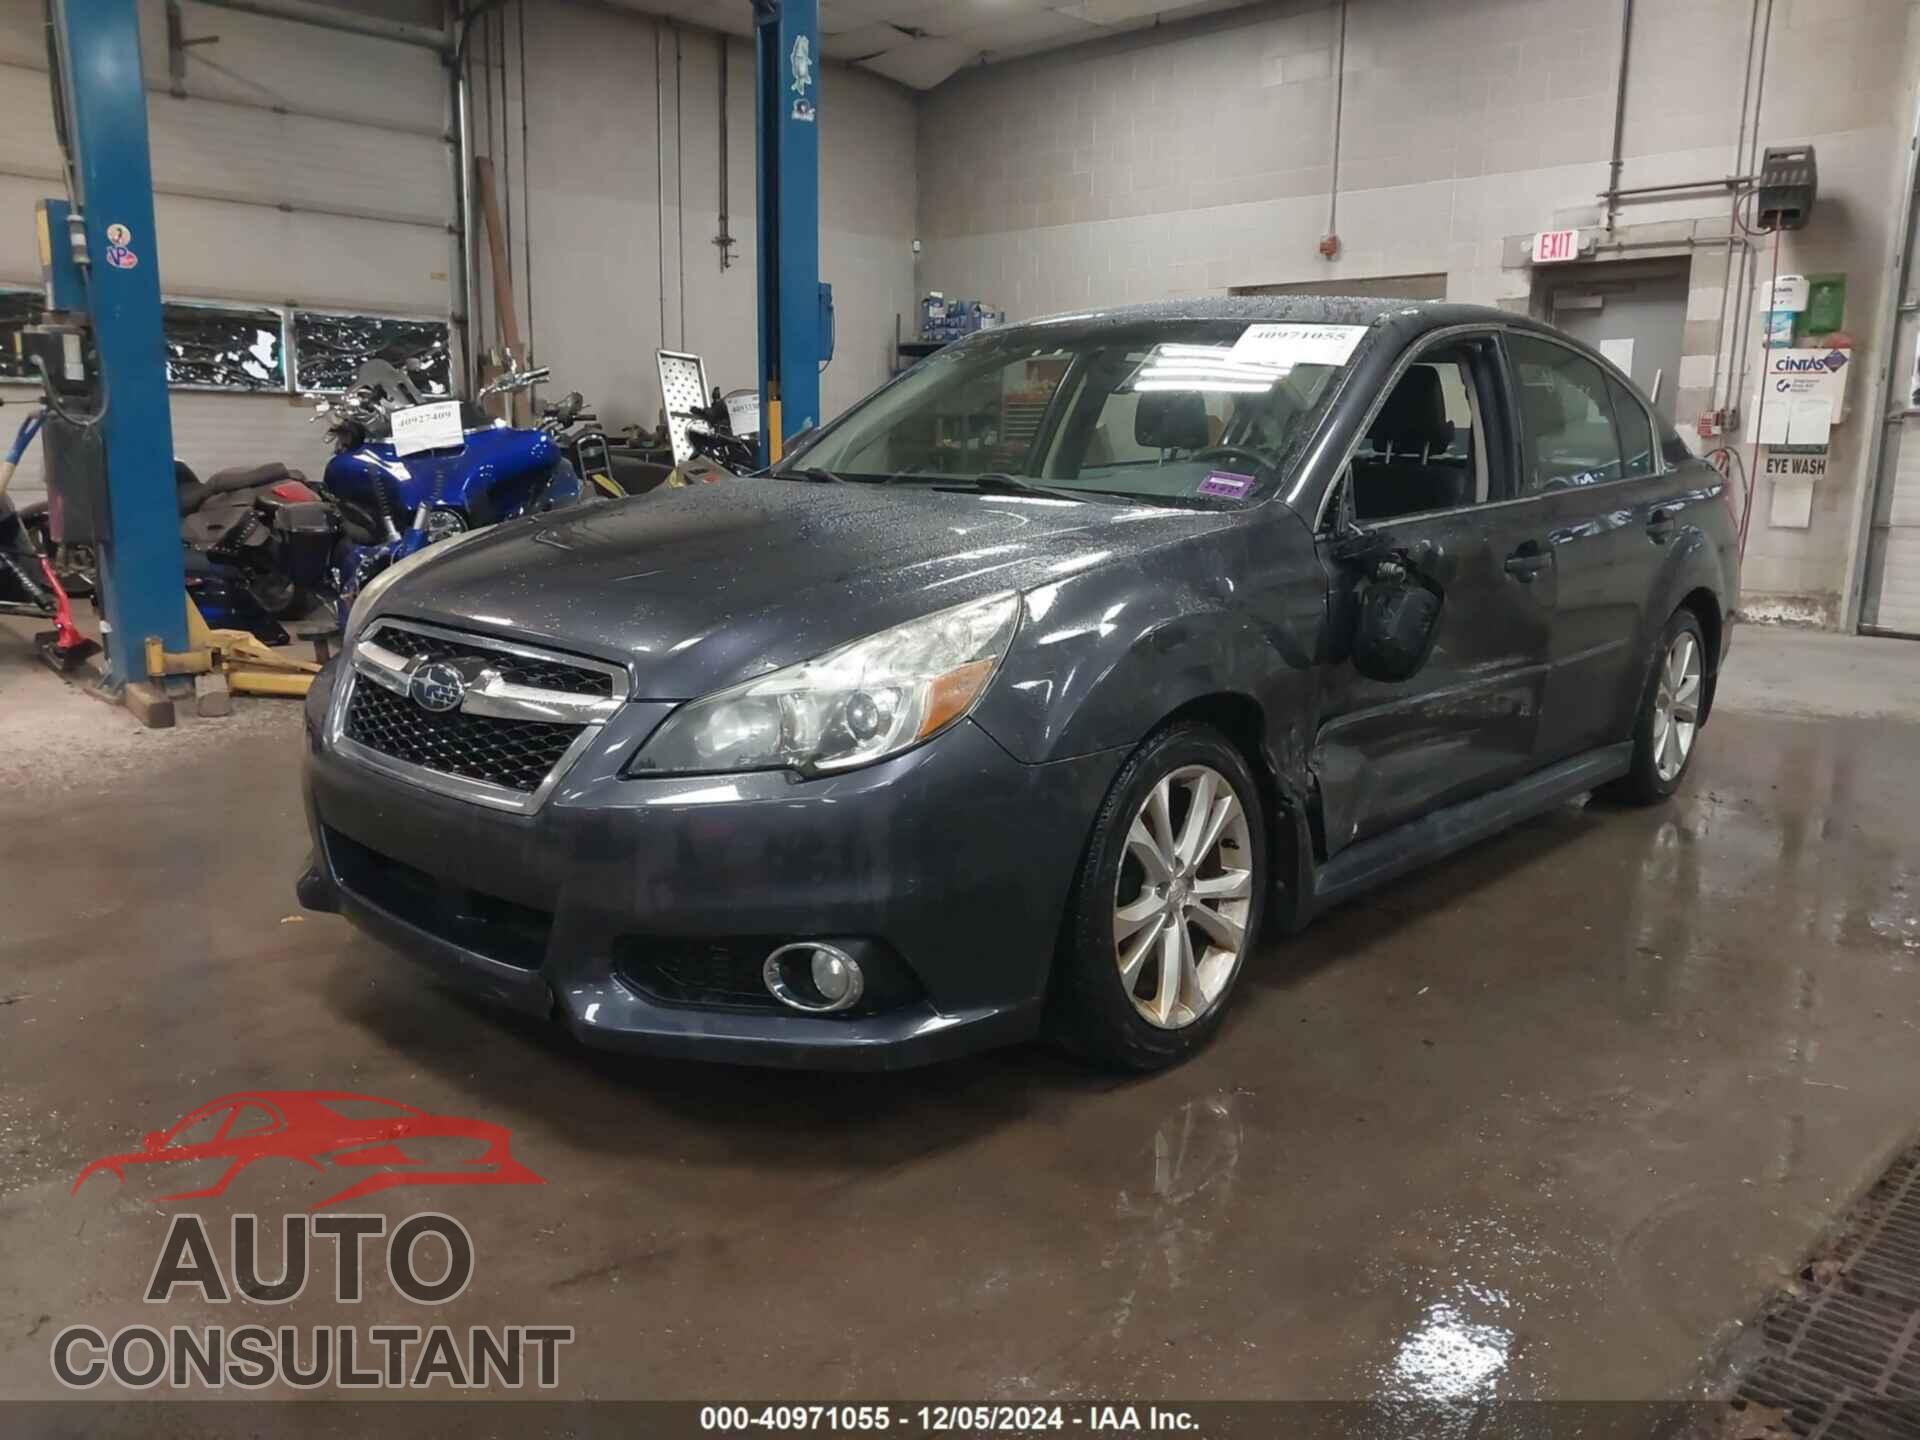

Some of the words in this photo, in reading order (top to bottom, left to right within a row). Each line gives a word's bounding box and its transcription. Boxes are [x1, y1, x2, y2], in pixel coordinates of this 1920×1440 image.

[1540, 231, 1573, 259] EXIT
[1766, 458, 1789, 474] EYE
[1791, 458, 1827, 475] WASH
